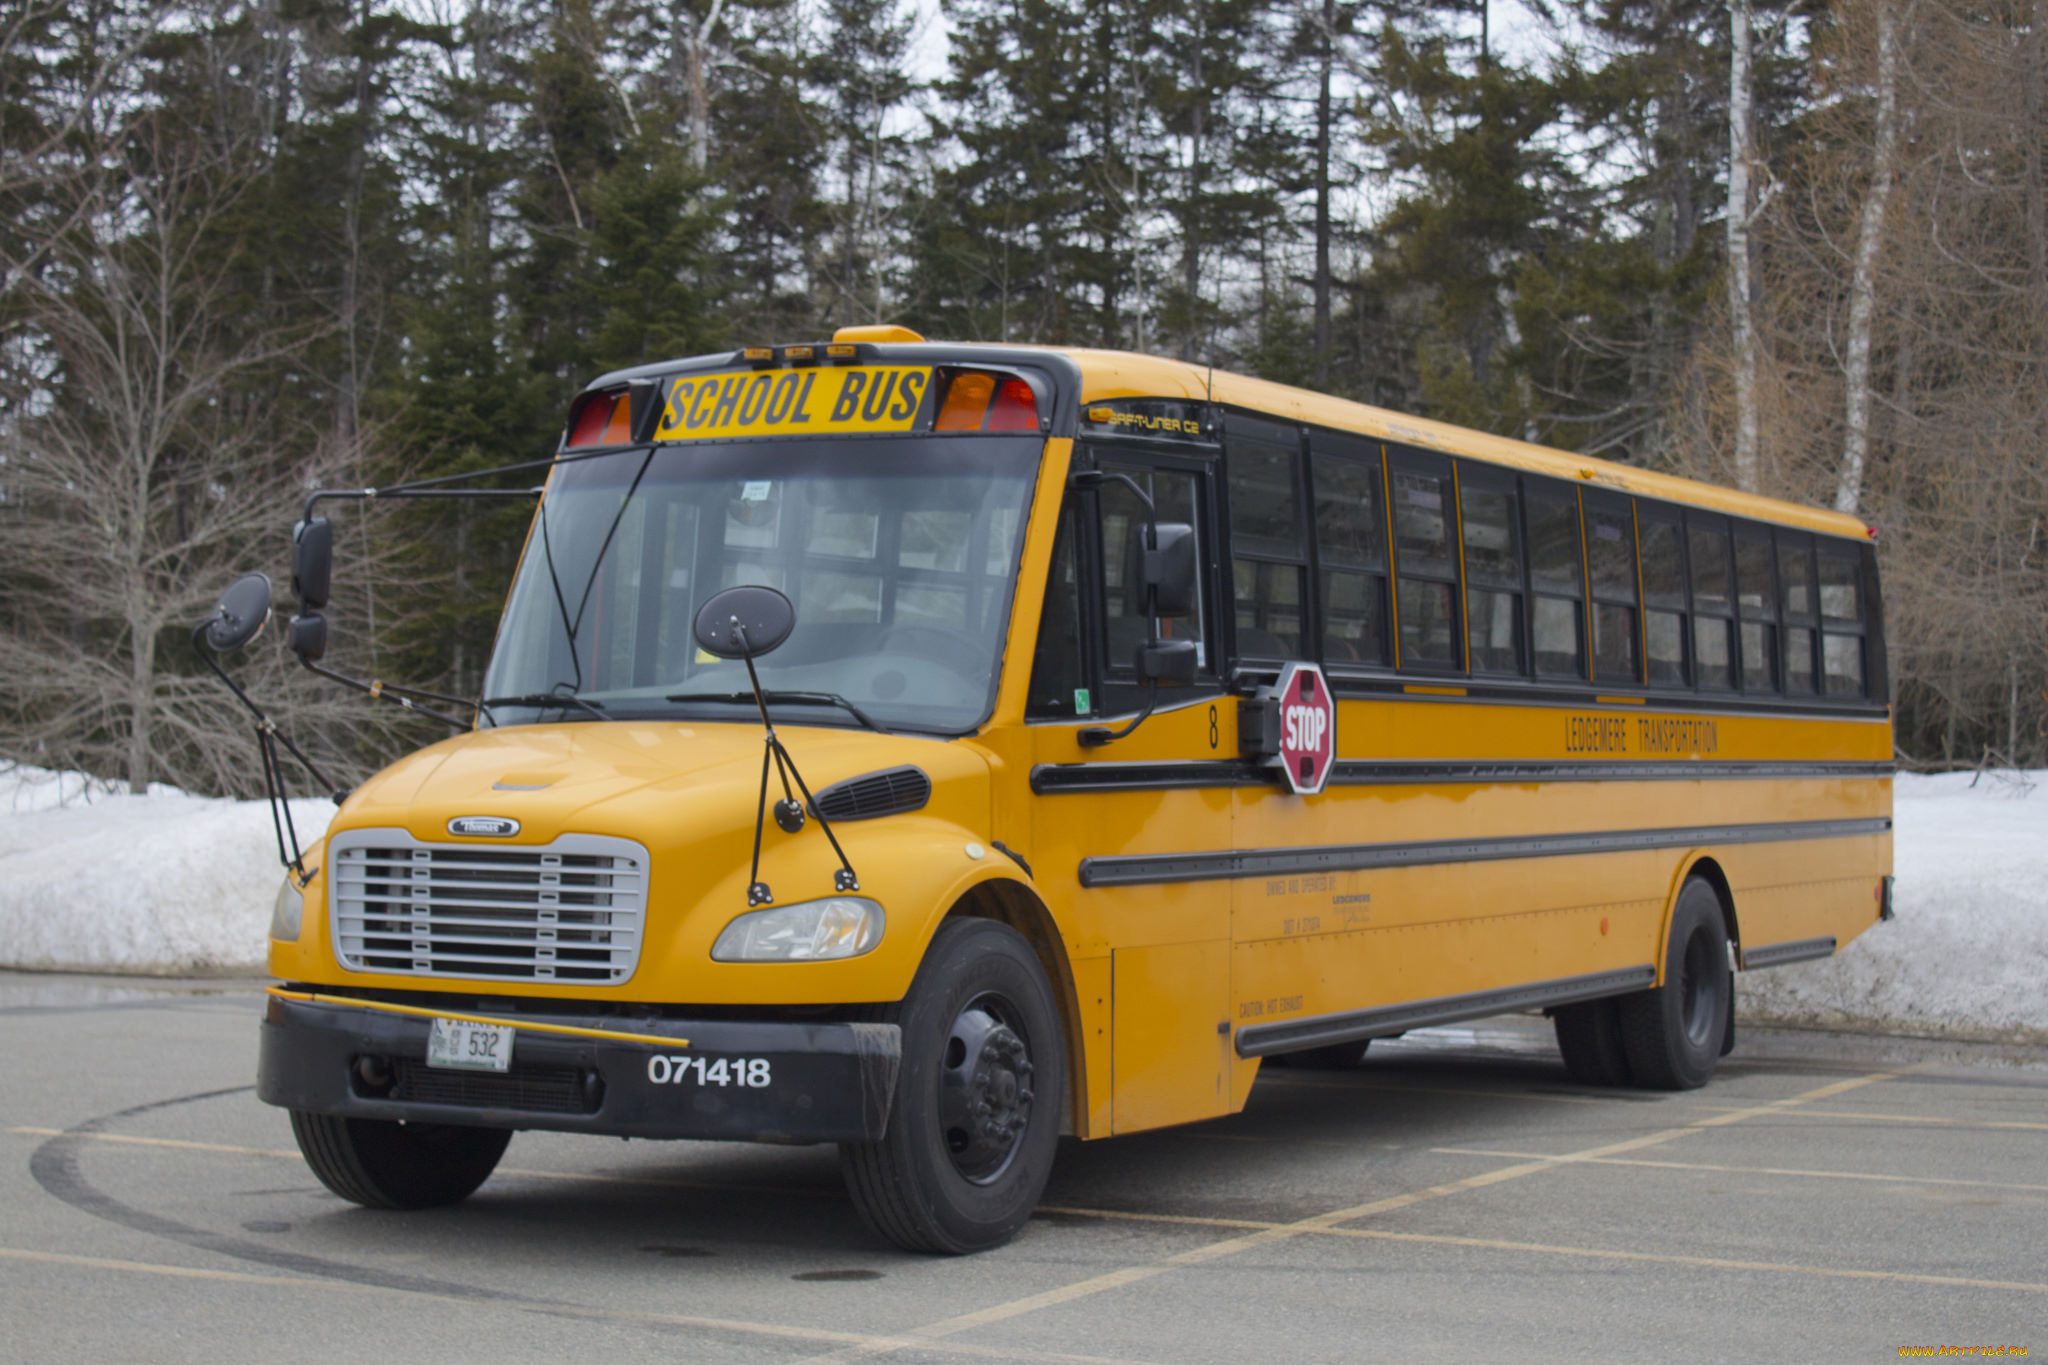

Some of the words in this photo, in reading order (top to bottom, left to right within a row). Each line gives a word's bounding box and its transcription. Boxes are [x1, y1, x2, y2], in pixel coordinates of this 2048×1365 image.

[662, 372, 817, 431] SCHOOL
[829, 371, 926, 422] BUS
[1209, 704, 1218, 749] 8
[1286, 705, 1326, 752] STOP
[1565, 716, 1626, 752] LEDGEMERE
[468, 1031, 500, 1057] 532
[649, 1054, 772, 1088] 071418
